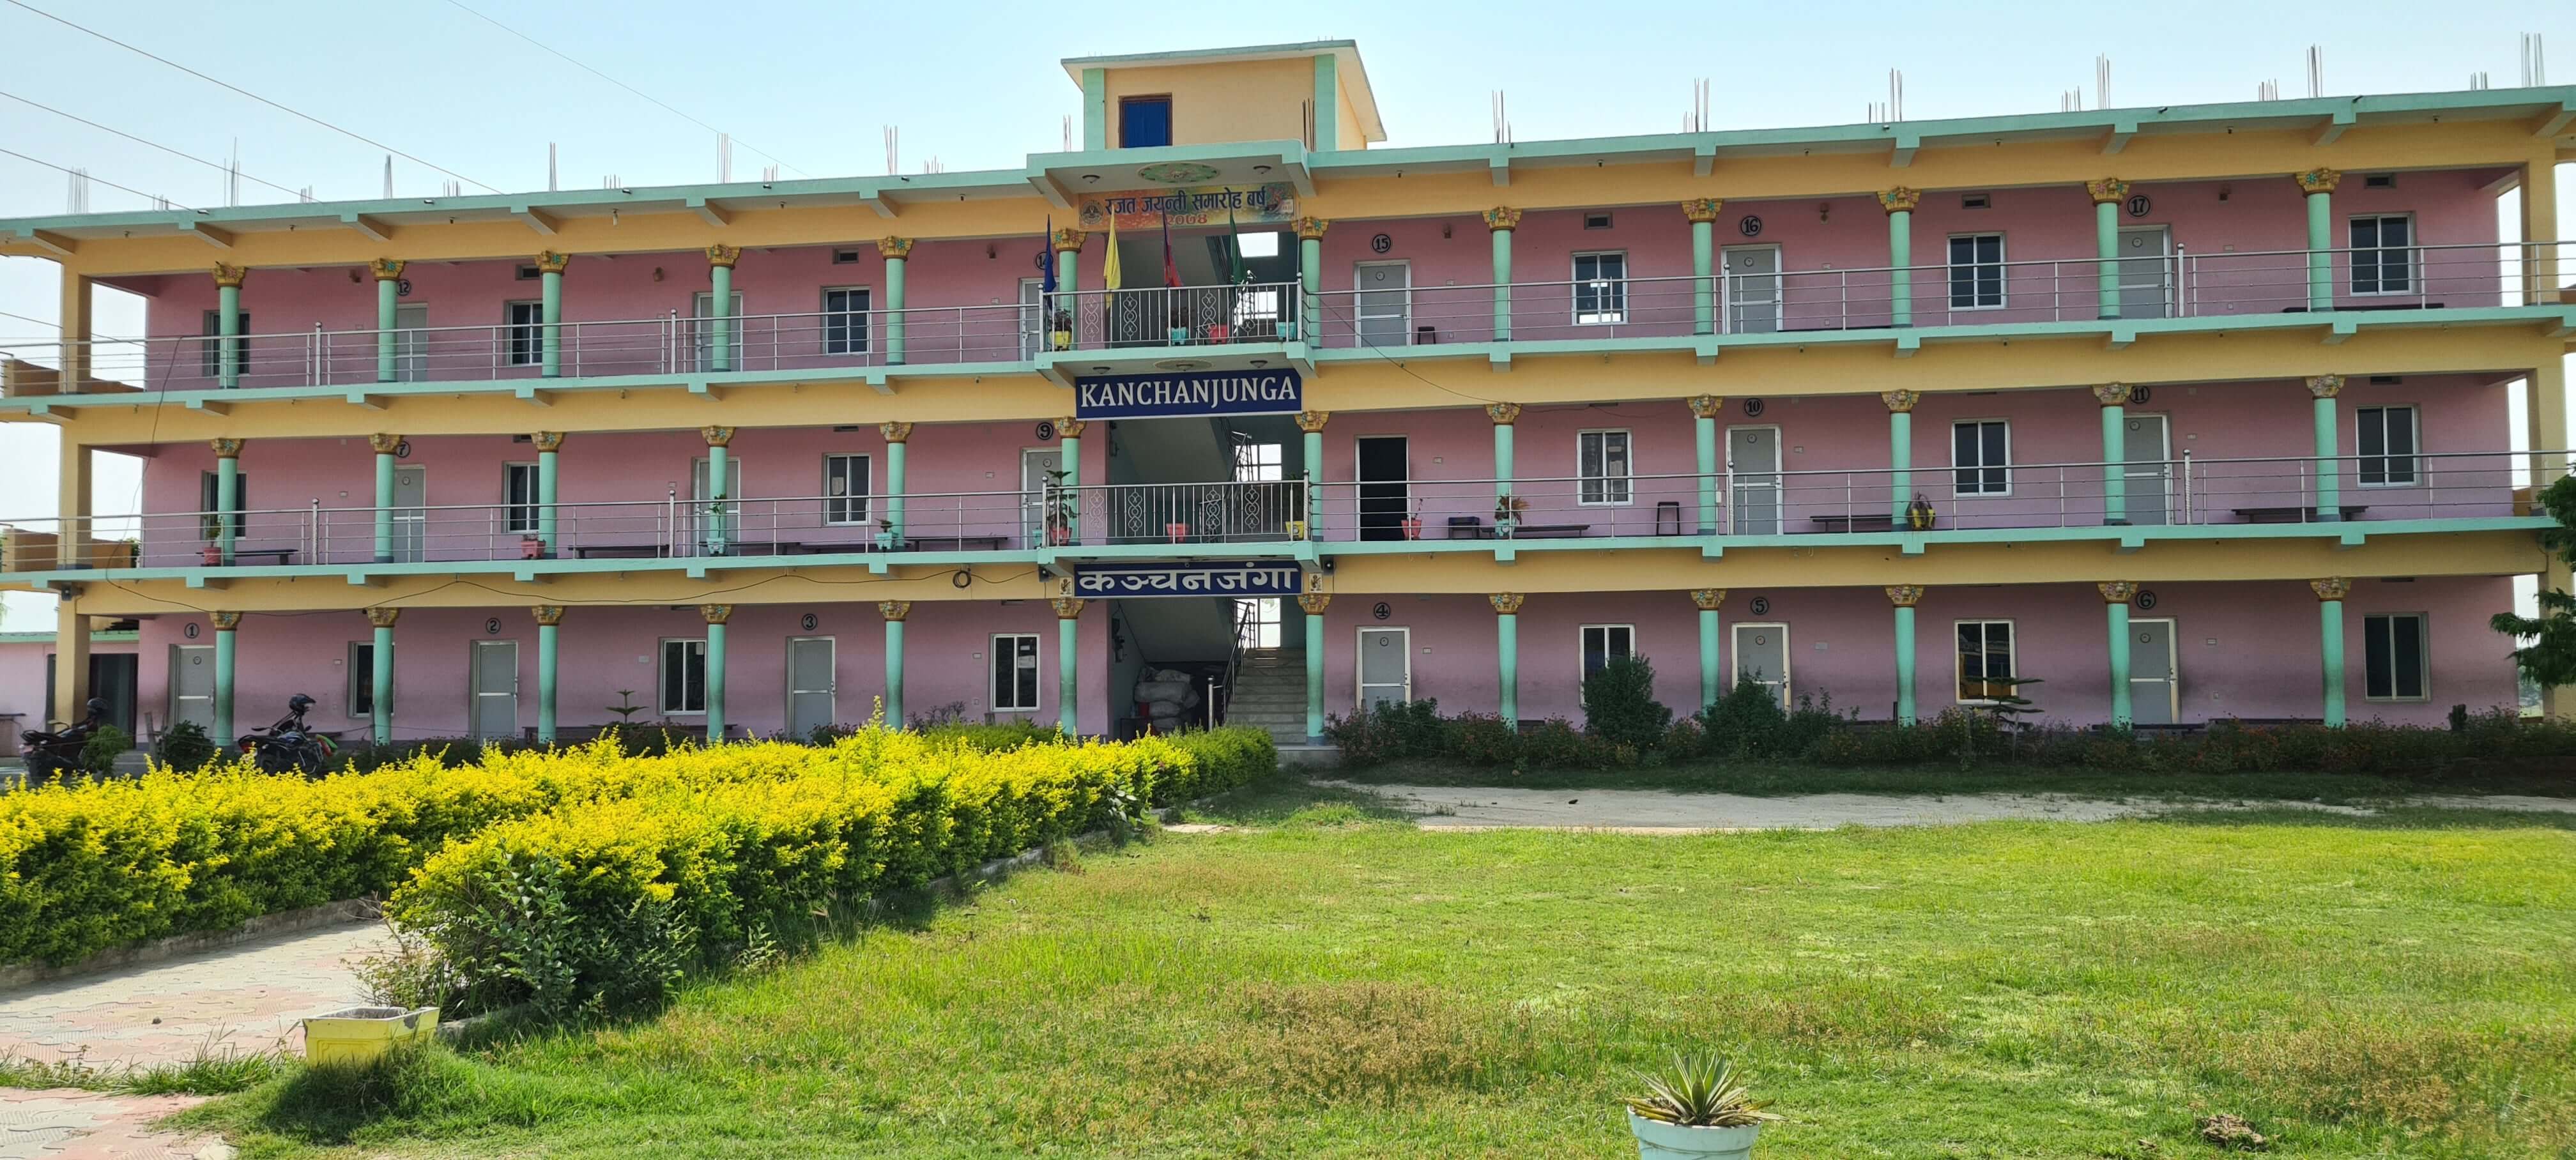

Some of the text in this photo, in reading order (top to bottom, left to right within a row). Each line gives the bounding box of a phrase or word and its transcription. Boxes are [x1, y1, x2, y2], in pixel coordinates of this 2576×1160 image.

[1104, 197, 1137, 215] रजत
[1140, 190, 1187, 213] जयन्ती
[1192, 187, 1243, 210] समारोह
[2131, 199, 2145, 213] 17
[1744, 219, 1757, 233] 16
[1376, 238, 1388, 249] 15
[399, 282, 410, 293] 12
[1081, 376, 1296, 408] KANCHANJUNGA
[2134, 388, 2146, 401] 11
[1748, 401, 1760, 412] 10
[1078, 561, 1298, 591] कञ्चनजंगा
